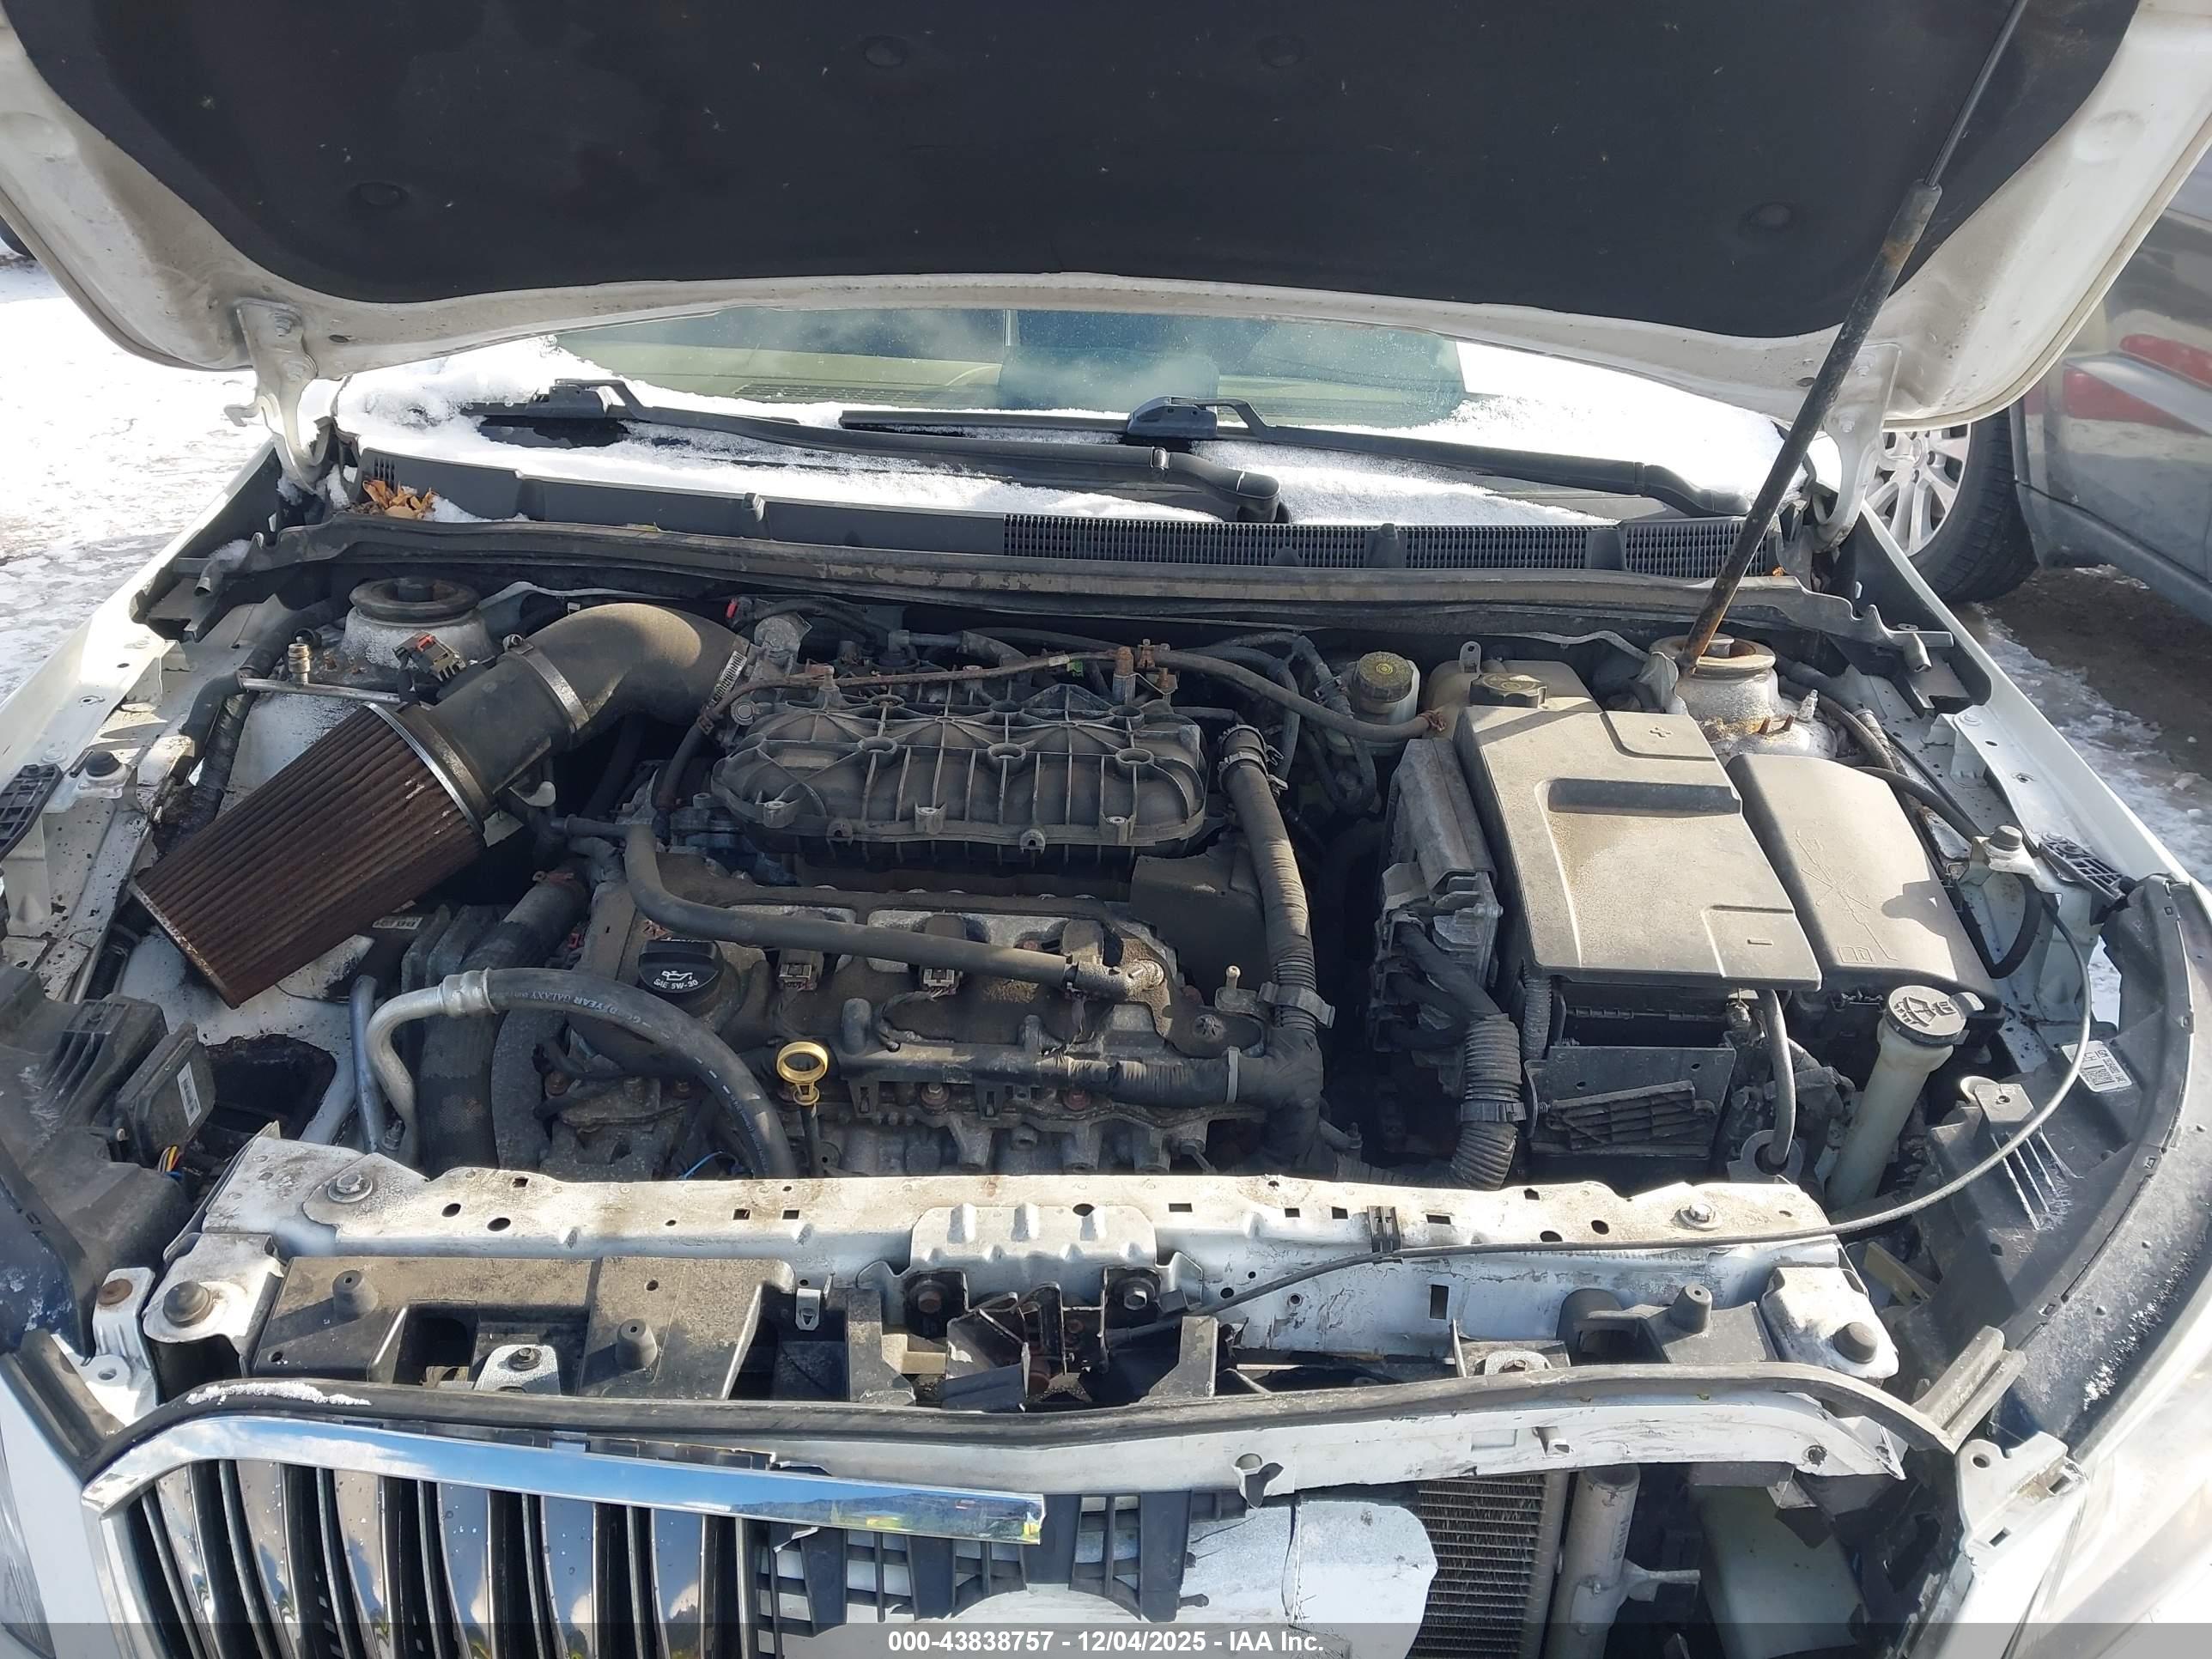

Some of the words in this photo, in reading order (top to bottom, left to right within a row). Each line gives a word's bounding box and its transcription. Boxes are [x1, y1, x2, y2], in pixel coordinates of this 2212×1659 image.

[653, 978, 669, 989] SAE
[671, 979, 699, 990] 5W-30
[531, 990, 571, 1002] GALAXY
[574, 997, 642, 1024] GODYEAR
[2098, 1049, 2110, 1058] GM
